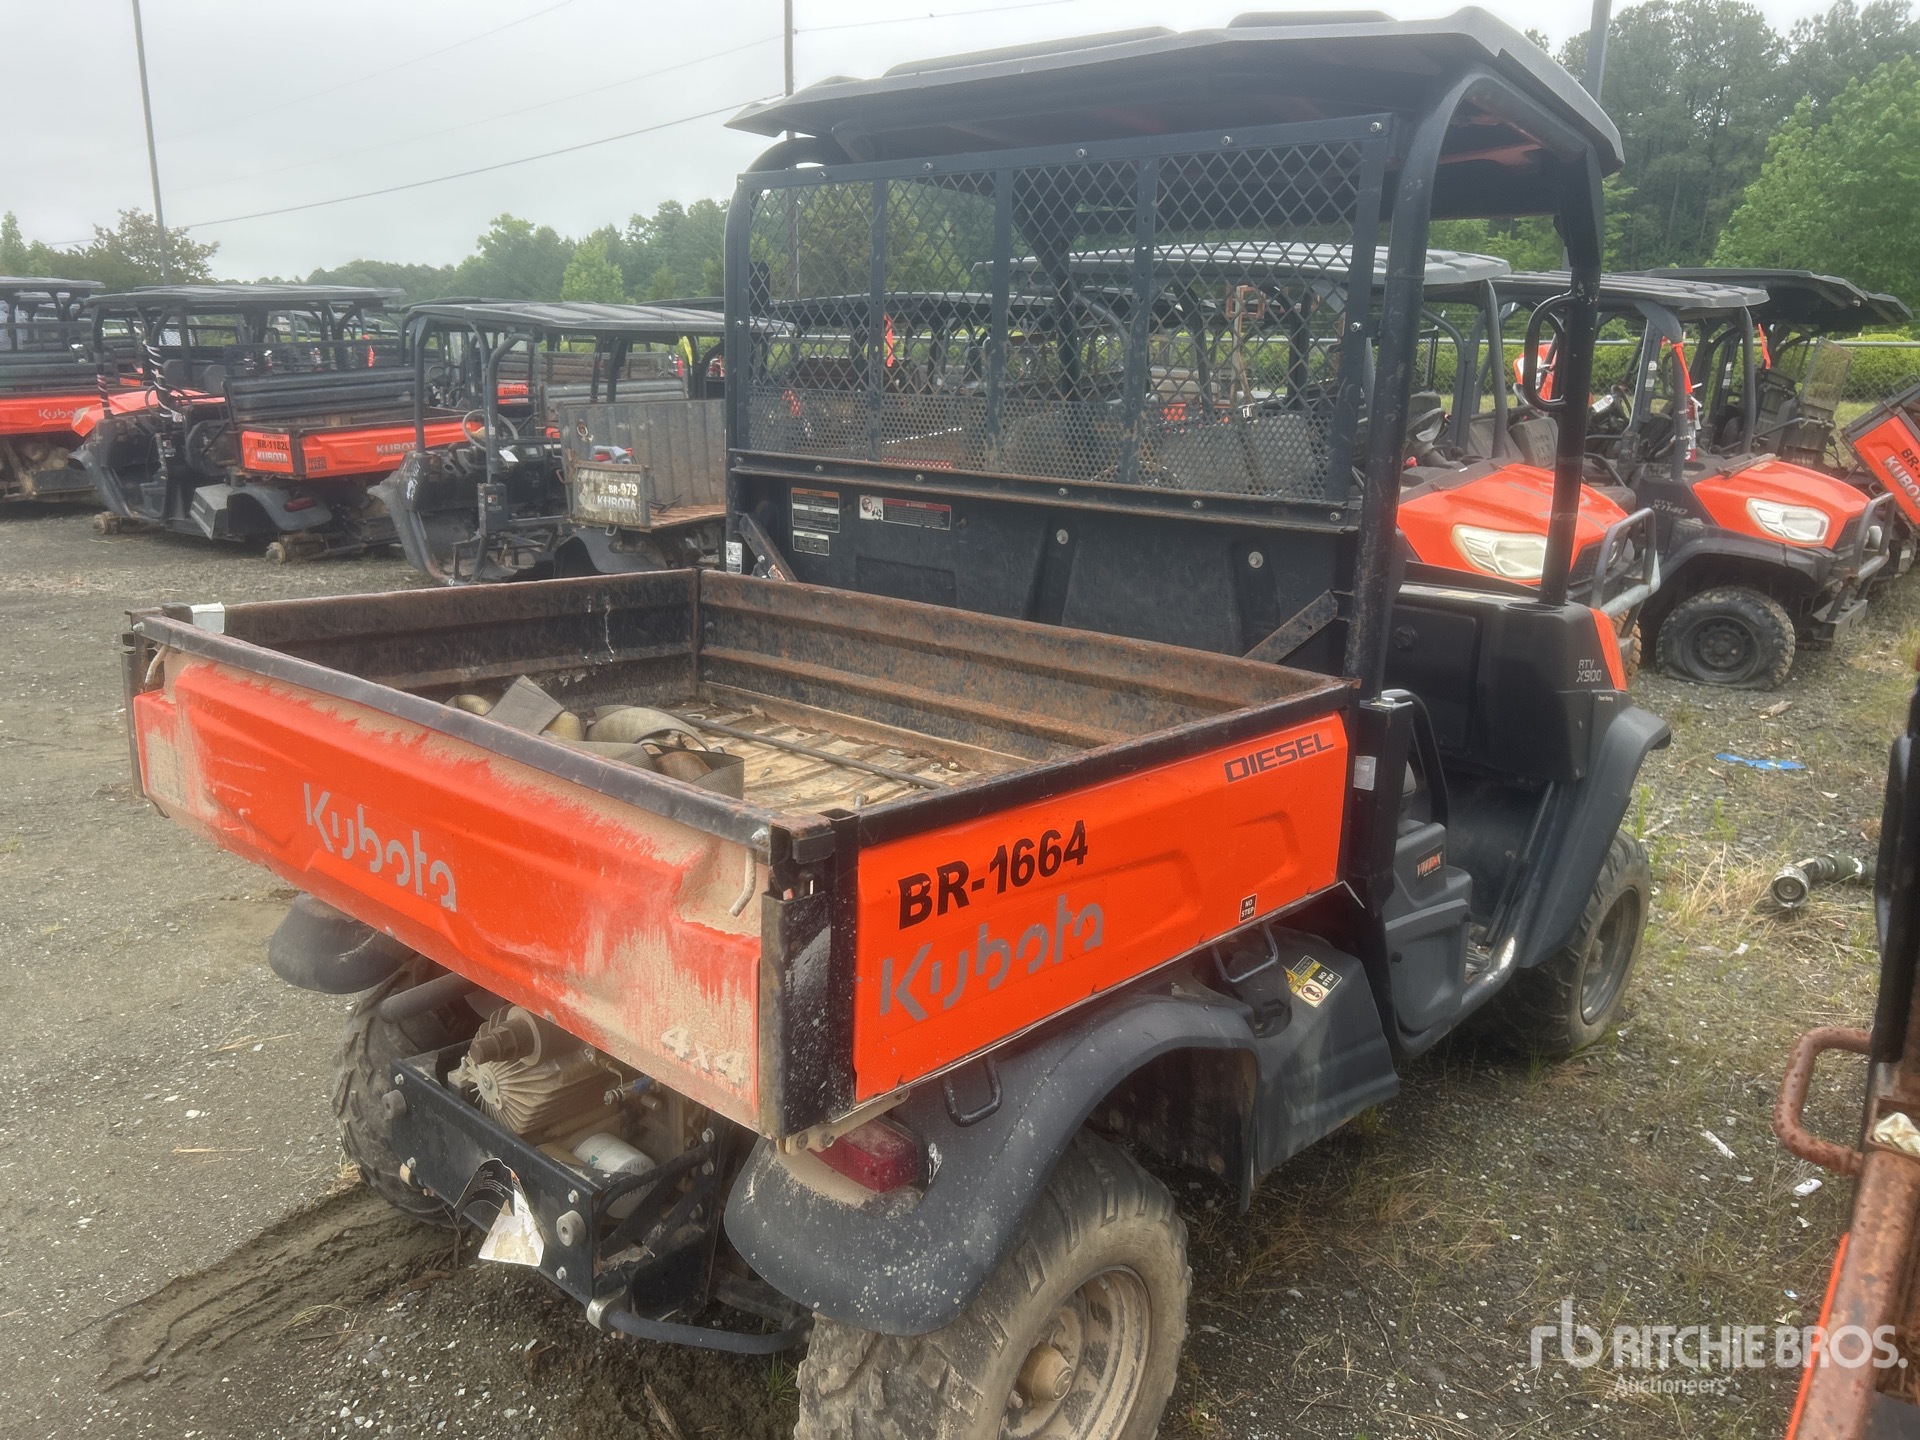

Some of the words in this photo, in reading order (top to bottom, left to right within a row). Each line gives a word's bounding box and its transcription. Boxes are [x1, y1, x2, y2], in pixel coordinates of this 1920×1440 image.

[257, 451, 289, 464] KUBOTA
[608, 482, 638, 496] BR-979
[597, 495, 637, 512] KUBOTA
[1578, 659, 1595, 669] RTV
[1576, 669, 1602, 683] X900
[1224, 733, 1334, 783] DIESEL
[303, 782, 457, 912] Kubota
[898, 820, 1088, 930] BR-1664
[1244, 899, 1253, 908] NO
[1241, 906, 1254, 918] STEP
[880, 894, 1104, 1022] Kubota
[1318, 971, 1327, 980] NO
[1321, 973, 1335, 986] STEP
